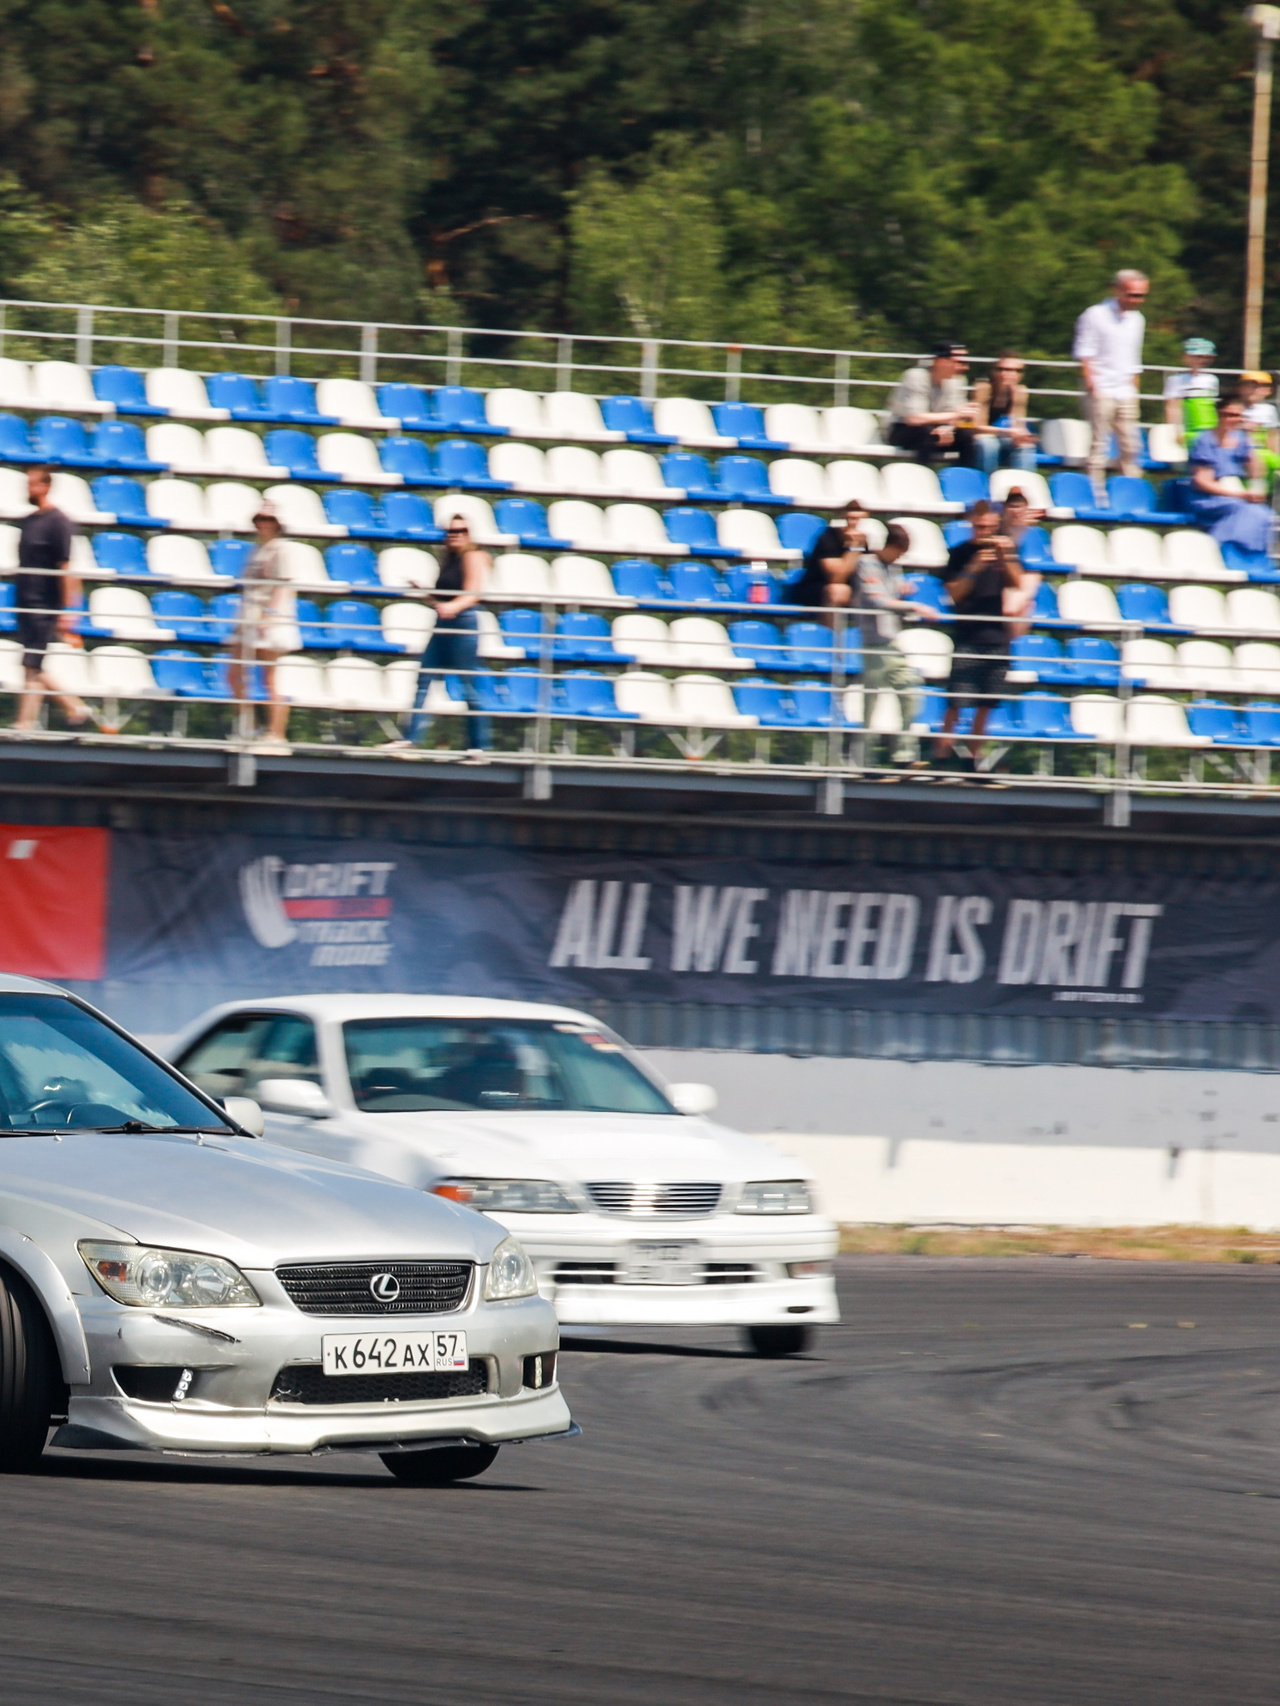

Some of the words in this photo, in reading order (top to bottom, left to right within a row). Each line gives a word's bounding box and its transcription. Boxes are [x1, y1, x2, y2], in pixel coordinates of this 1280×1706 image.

[548, 880, 653, 970] ALL
[670, 885, 769, 974] WE
[770, 889, 919, 980] NEED
[924, 895, 994, 983] IS
[997, 899, 1164, 988] DRIFT
[437, 1335, 458, 1357] 57
[436, 1357, 453, 1366] RUS
